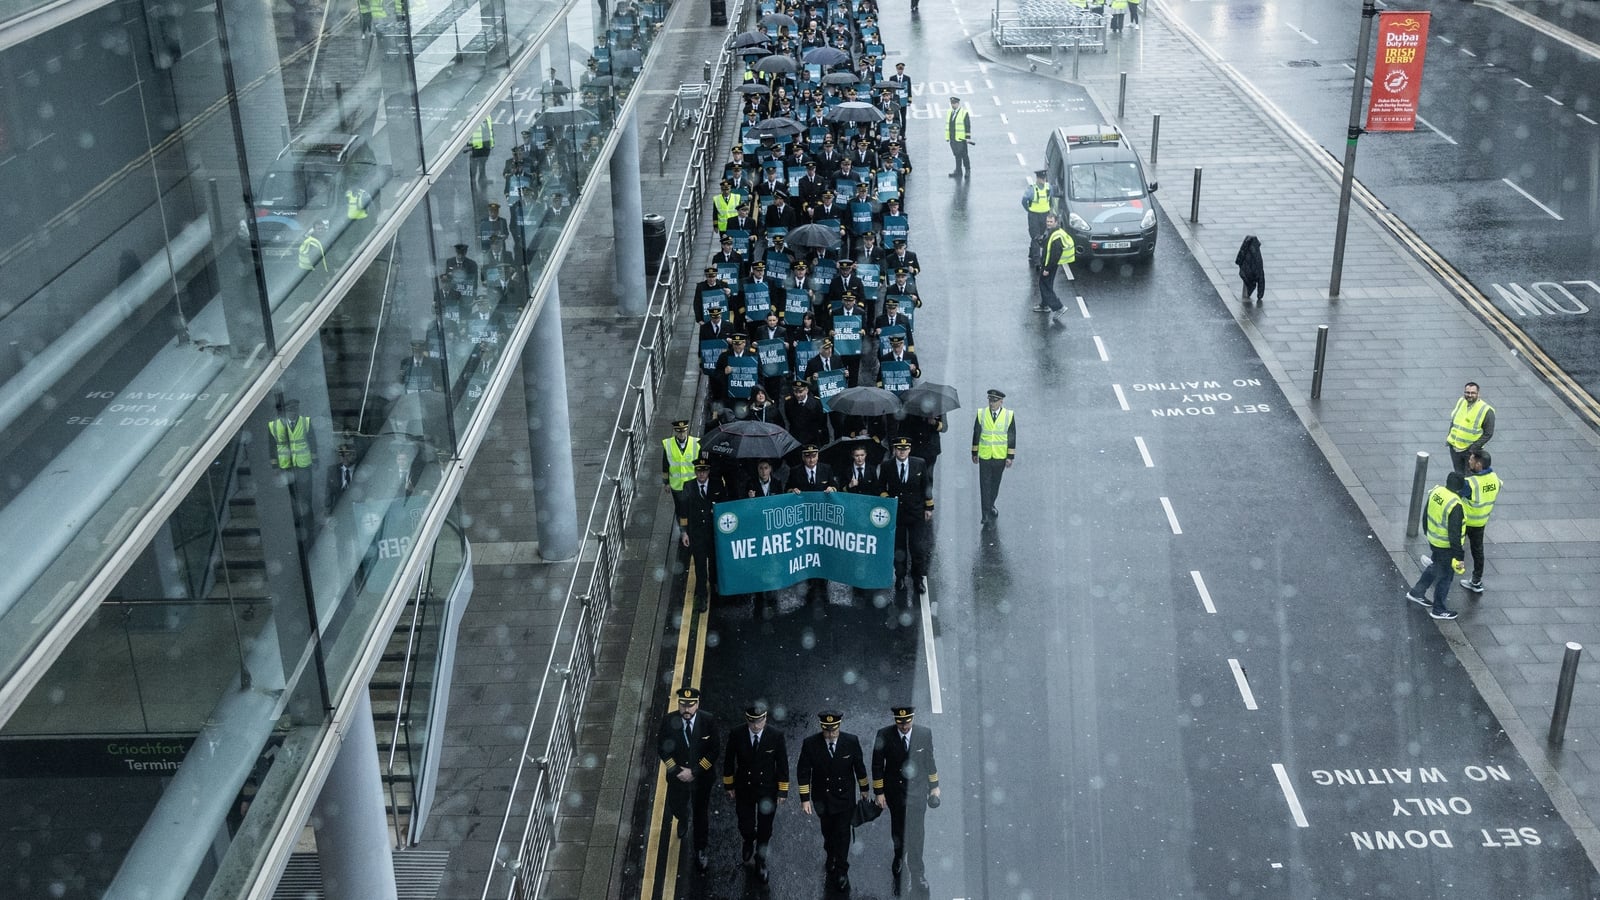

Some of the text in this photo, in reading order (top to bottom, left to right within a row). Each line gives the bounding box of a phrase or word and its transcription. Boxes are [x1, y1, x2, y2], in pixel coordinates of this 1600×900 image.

[1386, 33, 1419, 41] Dubai
[1386, 48, 1416, 57] IRISH
[912, 80, 975, 96] ROA
[731, 380, 743, 388] DEAL
[1132, 378, 1262, 392] NO WAITING
[1181, 392, 1232, 403] ONLY
[1151, 404, 1271, 417] SET DOWN
[763, 502, 845, 531] TOGETHER
[731, 525, 877, 560] WE ARE STRONGER
[789, 552, 821, 575] IALPA
[124, 758, 183, 770] Termina
[1312, 765, 1511, 786] NO WAITING
[1392, 796, 1472, 816] ONLY
[1351, 827, 1542, 850] SET DOWN
